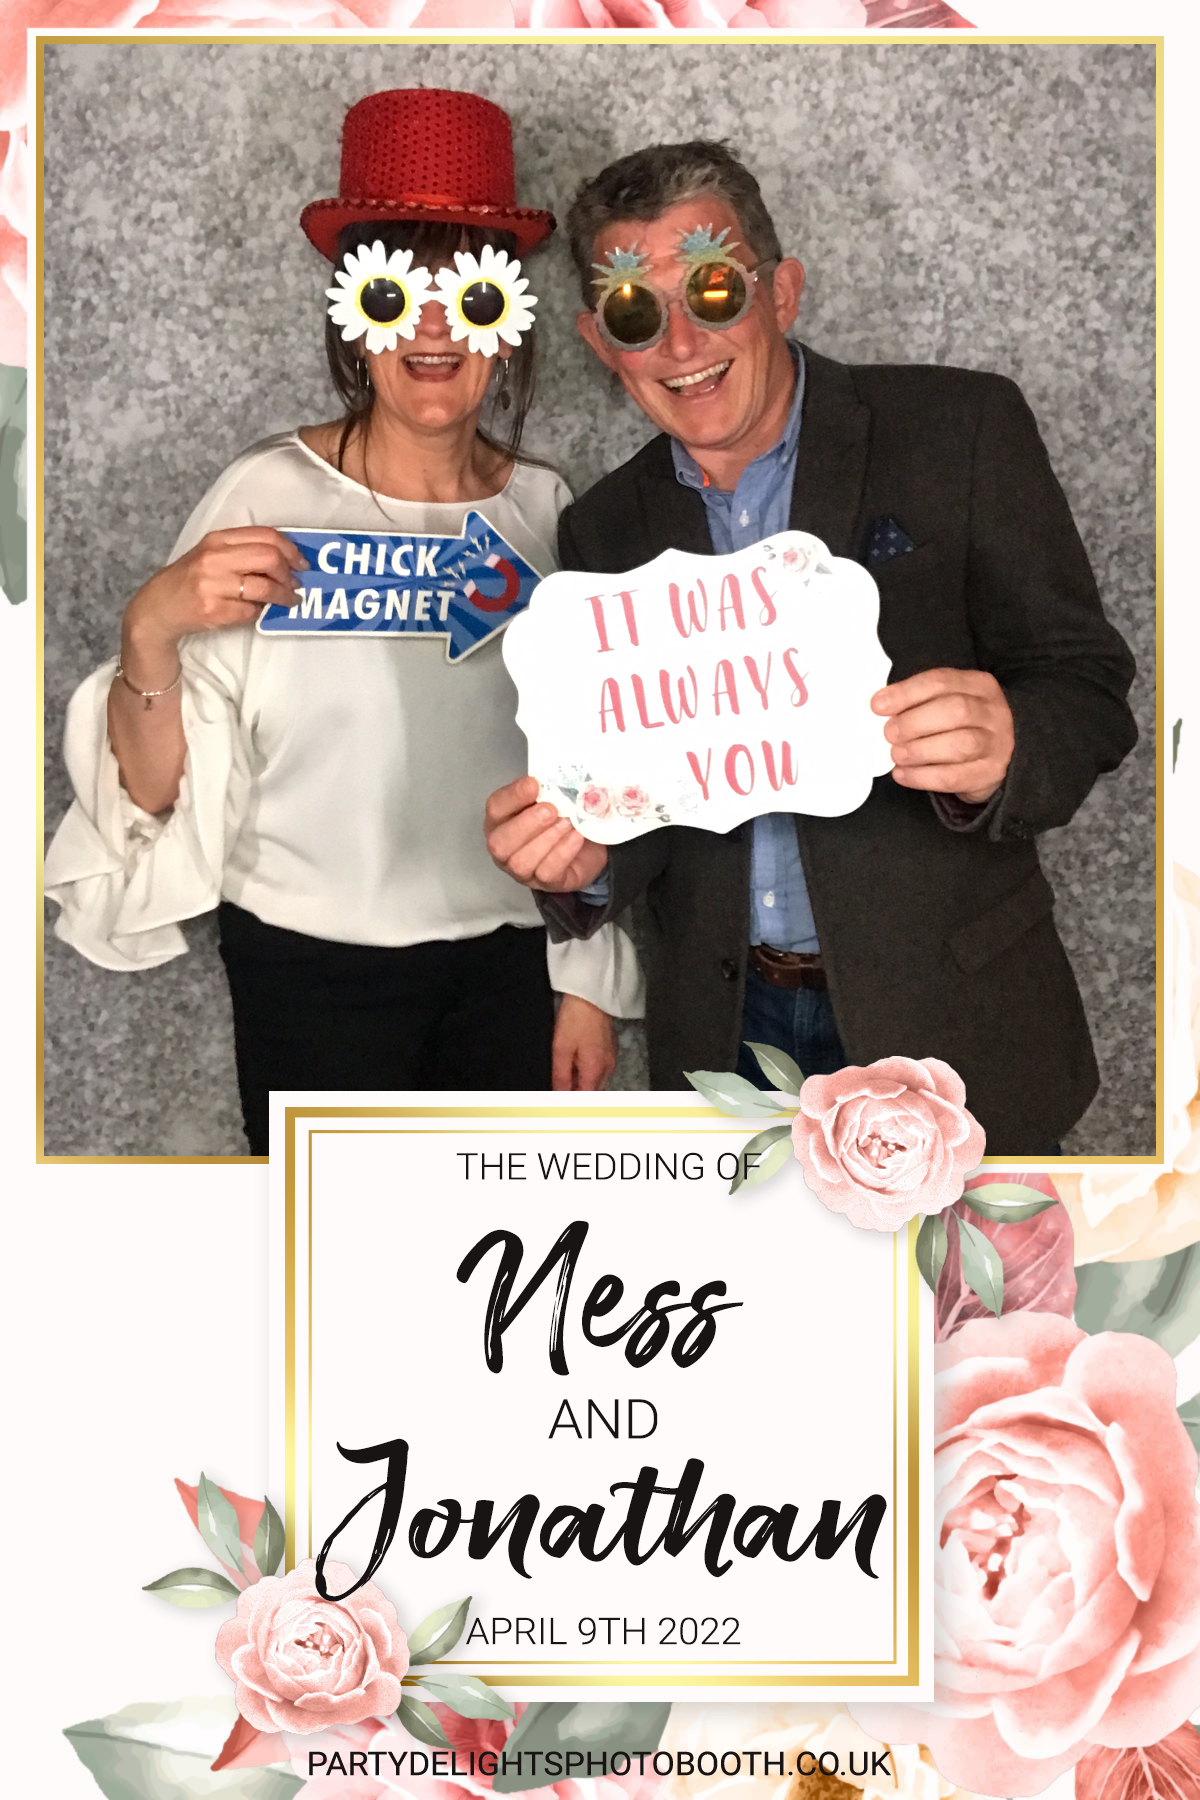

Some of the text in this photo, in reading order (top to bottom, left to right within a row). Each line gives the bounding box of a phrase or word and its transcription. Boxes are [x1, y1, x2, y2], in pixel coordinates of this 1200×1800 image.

[317, 541, 441, 577] CHICK
[288, 587, 455, 621] MAGNET
[585, 566, 778, 653] IT WAS
[598, 647, 809, 733] ALWAYS
[686, 740, 798, 801] YOU
